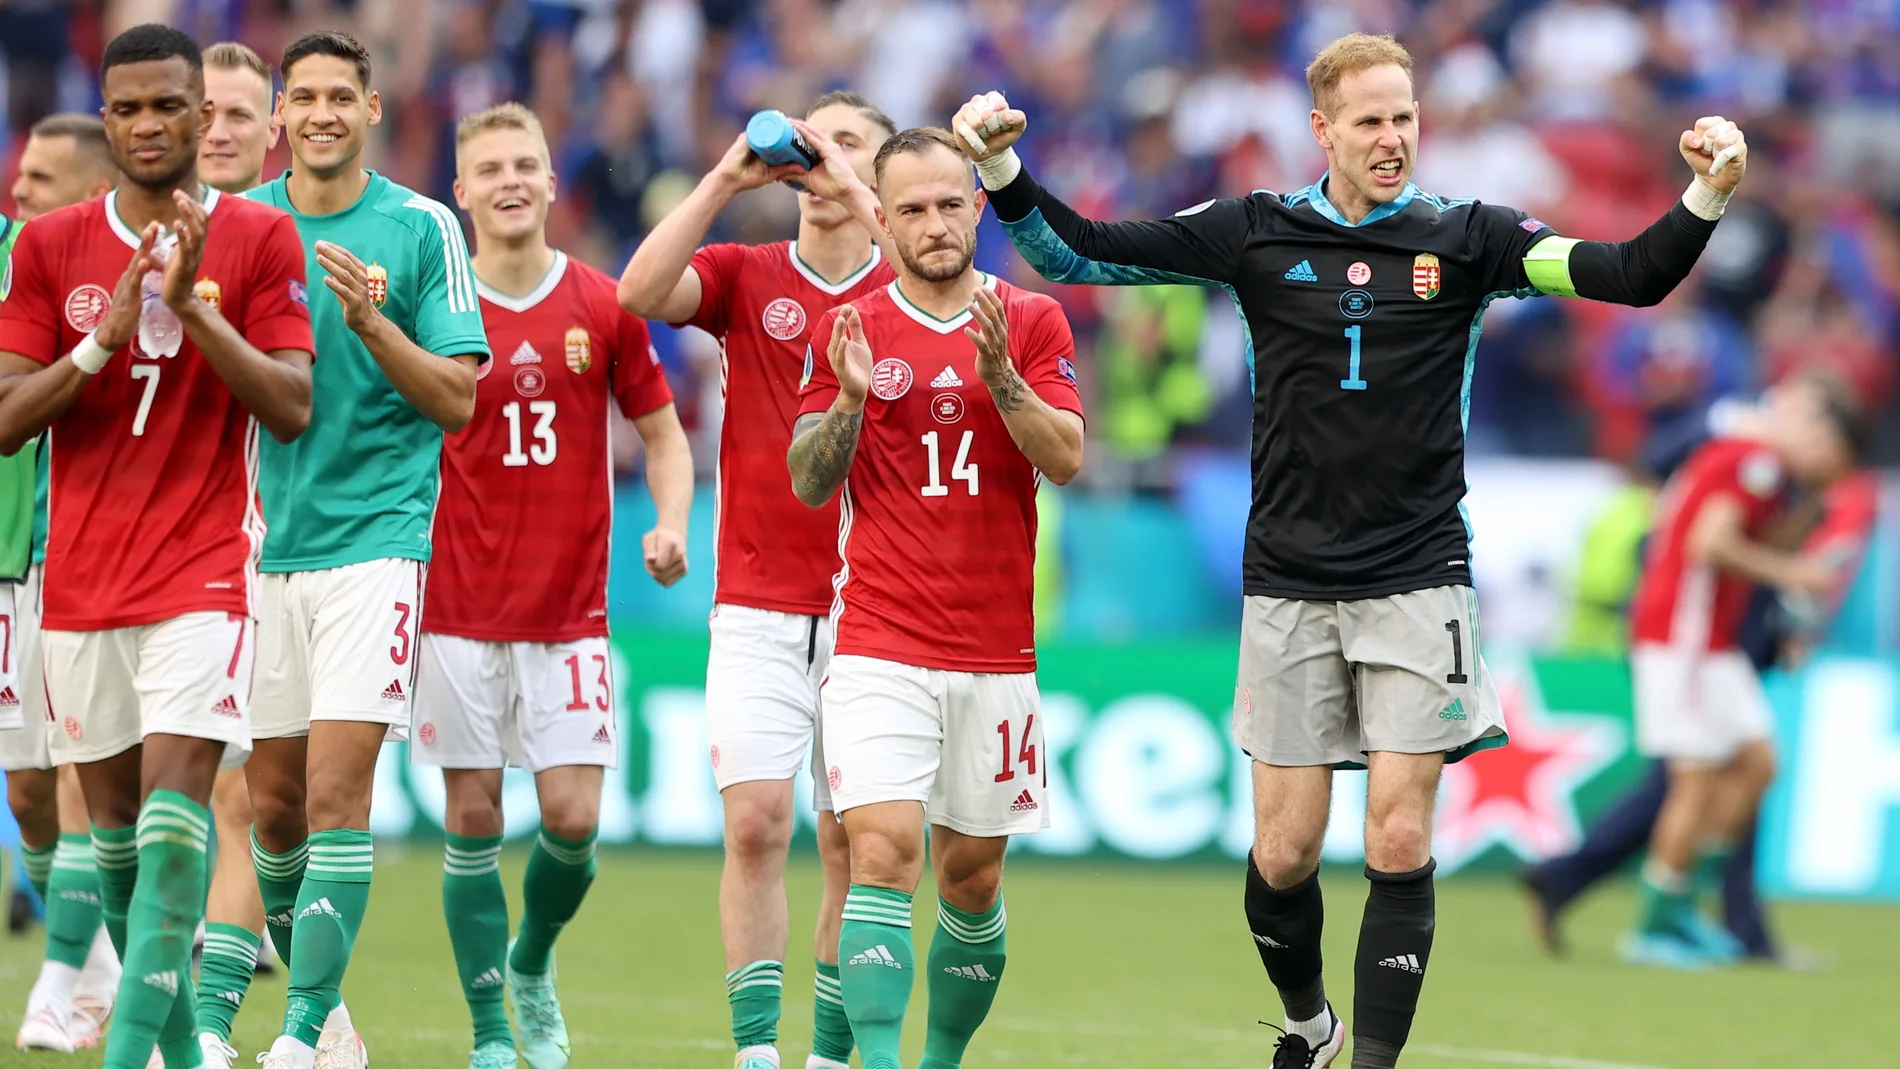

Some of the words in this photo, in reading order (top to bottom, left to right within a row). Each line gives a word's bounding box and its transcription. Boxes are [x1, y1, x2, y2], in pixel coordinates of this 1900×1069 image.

[1284, 272, 1318, 282] adidas
[930, 379, 963, 388] adidas
[1340, 325, 1367, 390] 1
[130, 364, 160, 436] 7
[502, 401, 557, 466] 13
[921, 430, 979, 496] 14
[227, 612, 246, 679] 7
[390, 602, 409, 665] 3
[1445, 619, 1467, 684] 1
[381, 691, 406, 702] adidas
[565, 655, 609, 712] 13
[1439, 711, 1467, 720] adidas
[994, 714, 1036, 783] 14
[1010, 802, 1037, 812] adidas
[849, 957, 901, 969] adidas
[1378, 961, 1423, 974] adidas
